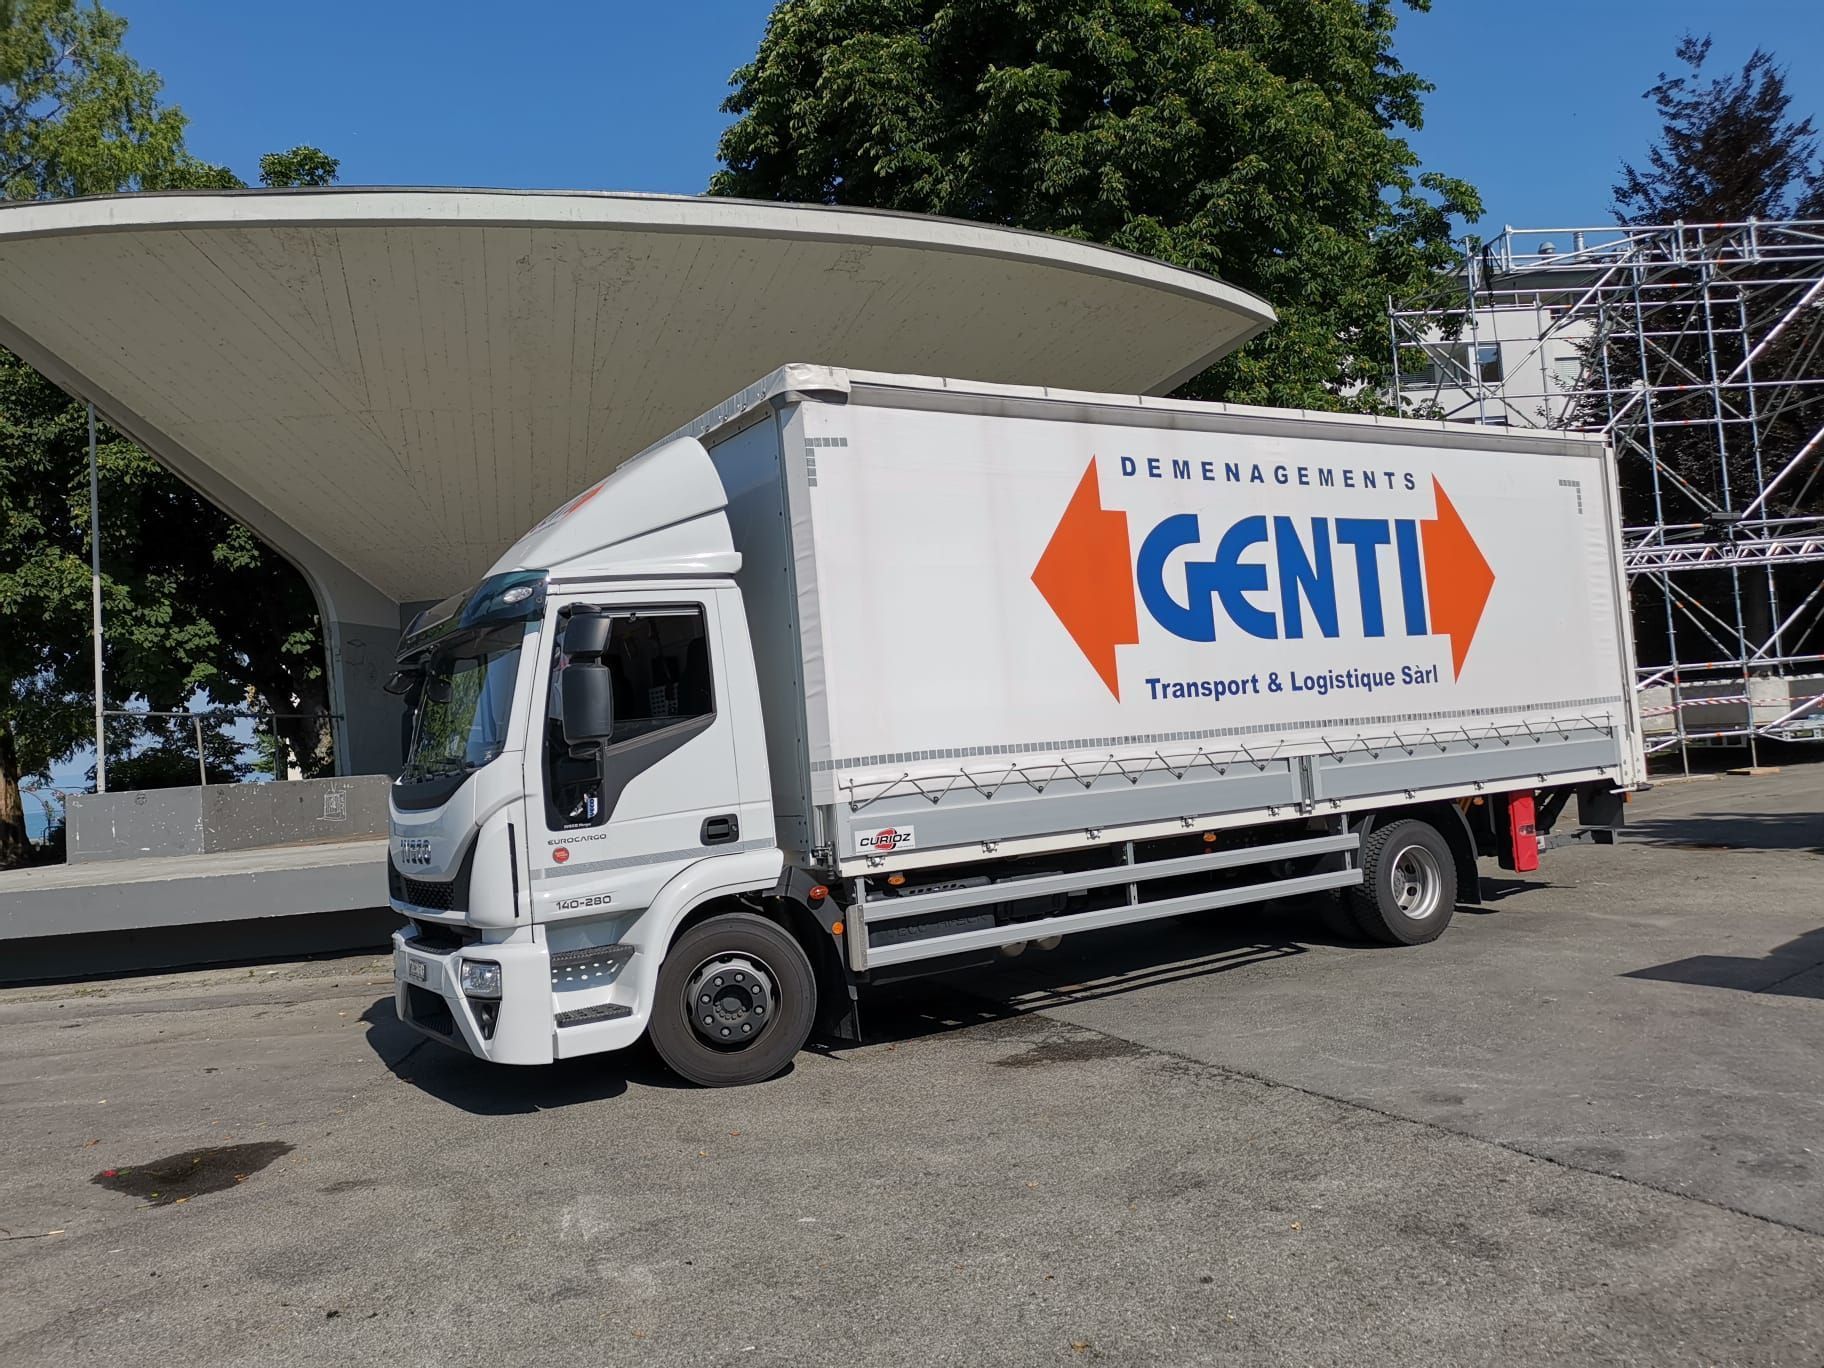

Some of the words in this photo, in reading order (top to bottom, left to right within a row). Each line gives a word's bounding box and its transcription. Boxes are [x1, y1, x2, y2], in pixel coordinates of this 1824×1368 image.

[1120, 456, 1416, 490] DEMENAGEMENTS
[1137, 513, 1428, 643] GENTI
[1145, 673, 1260, 701] Transport
[1267, 672, 1283, 692] &
[1290, 668, 1396, 696] Logistique
[1401, 664, 1438, 685] Sàrl
[547, 833, 607, 846] EUROCARGO
[860, 833, 912, 847] CURIOZ
[556, 895, 612, 911] 140-280
